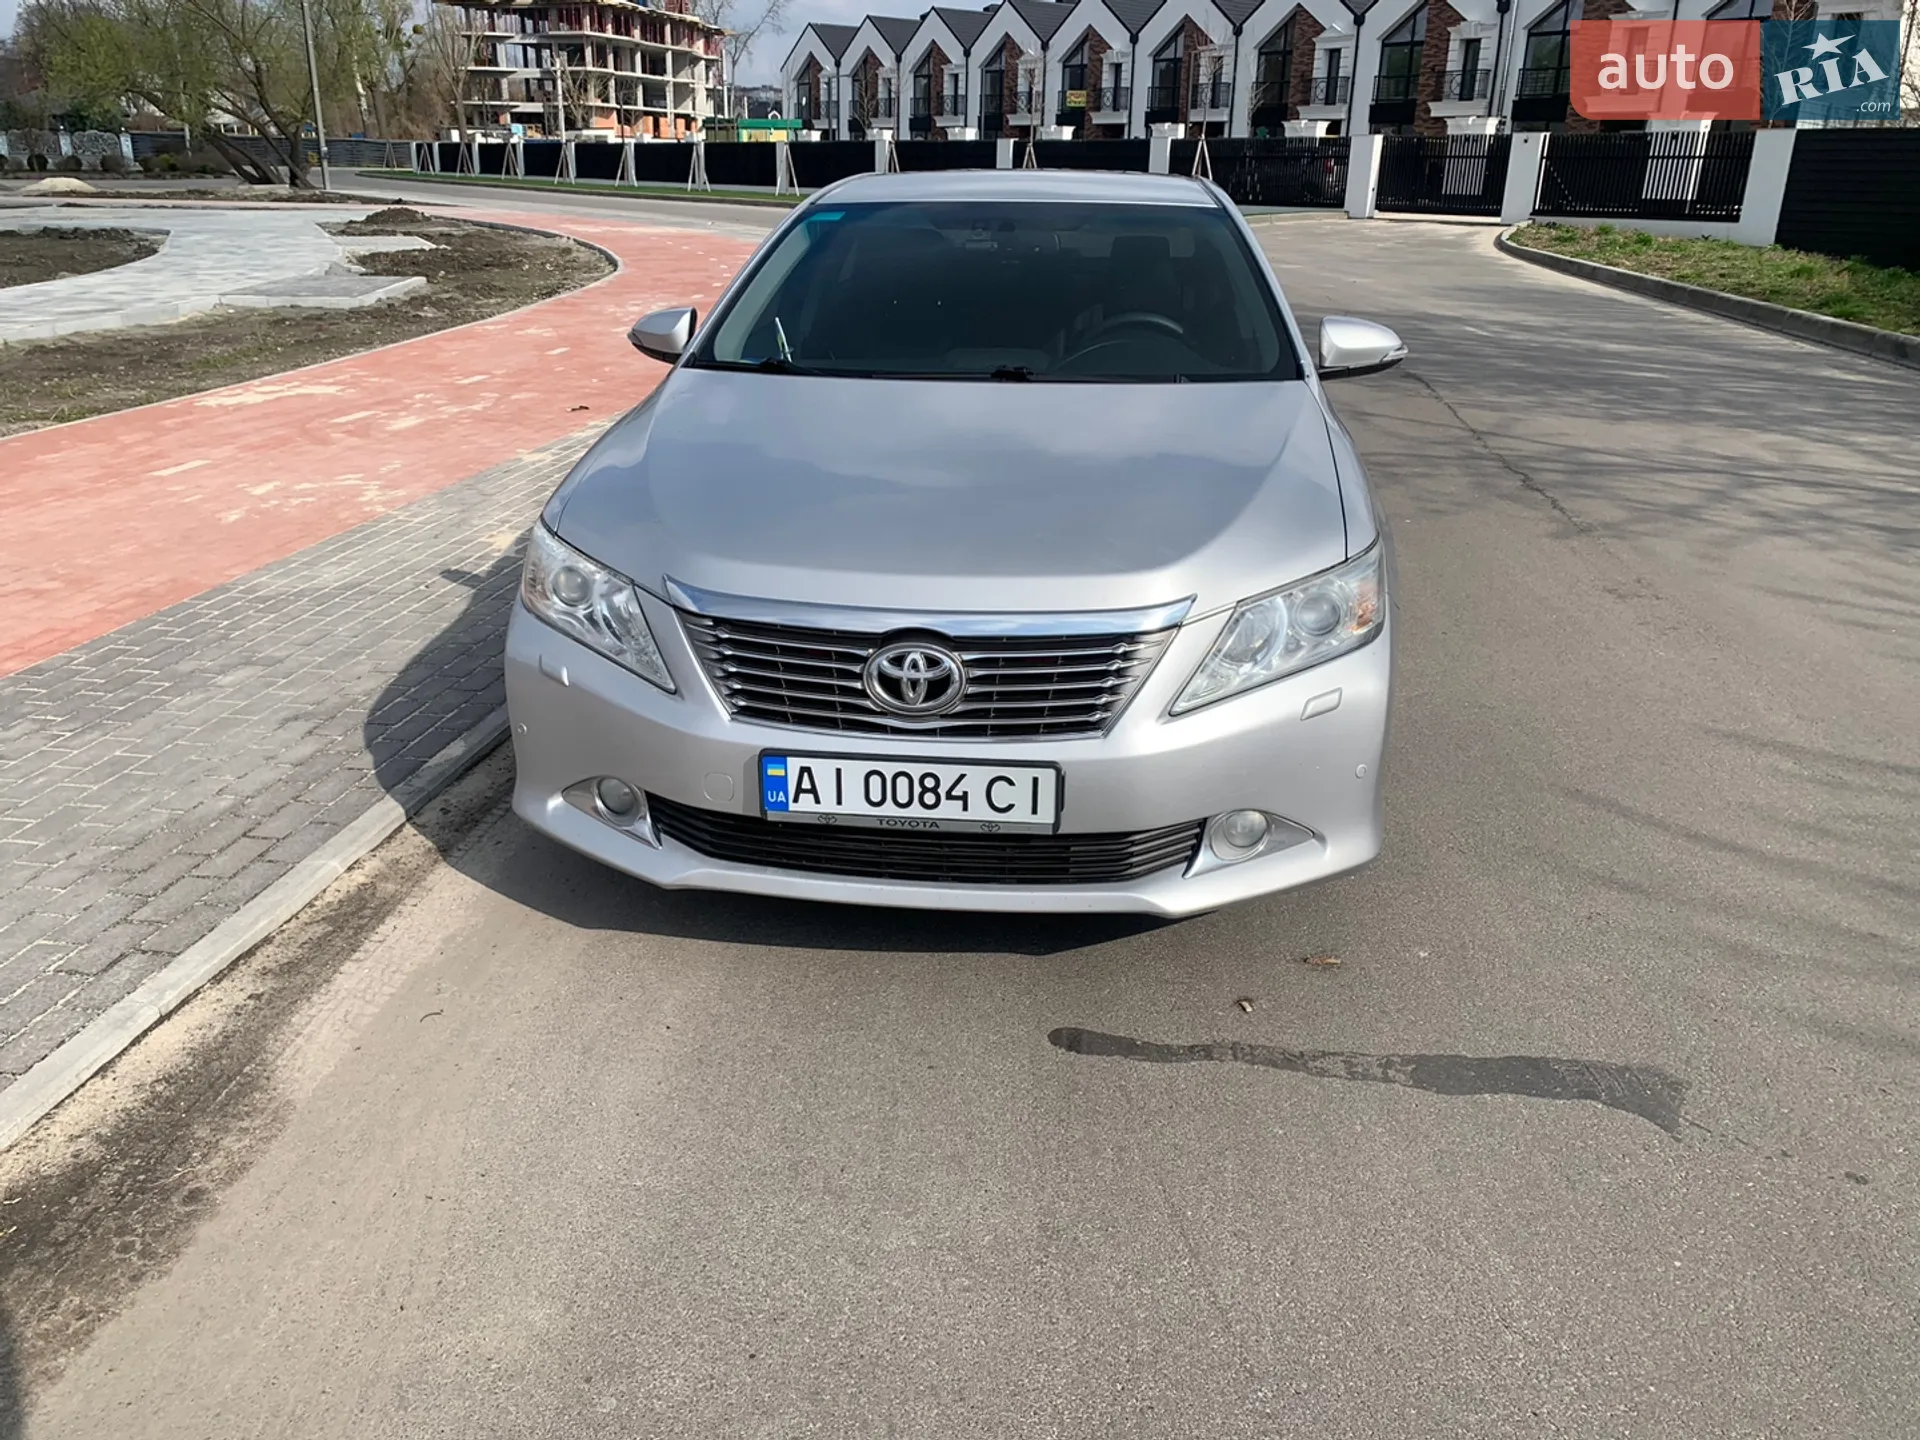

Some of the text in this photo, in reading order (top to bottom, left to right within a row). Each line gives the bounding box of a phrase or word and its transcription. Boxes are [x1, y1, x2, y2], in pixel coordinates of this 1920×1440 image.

[768, 790, 787, 803] UA
[792, 766, 1040, 816] AI 0084 CI
[876, 818, 940, 830] TOYOTA
